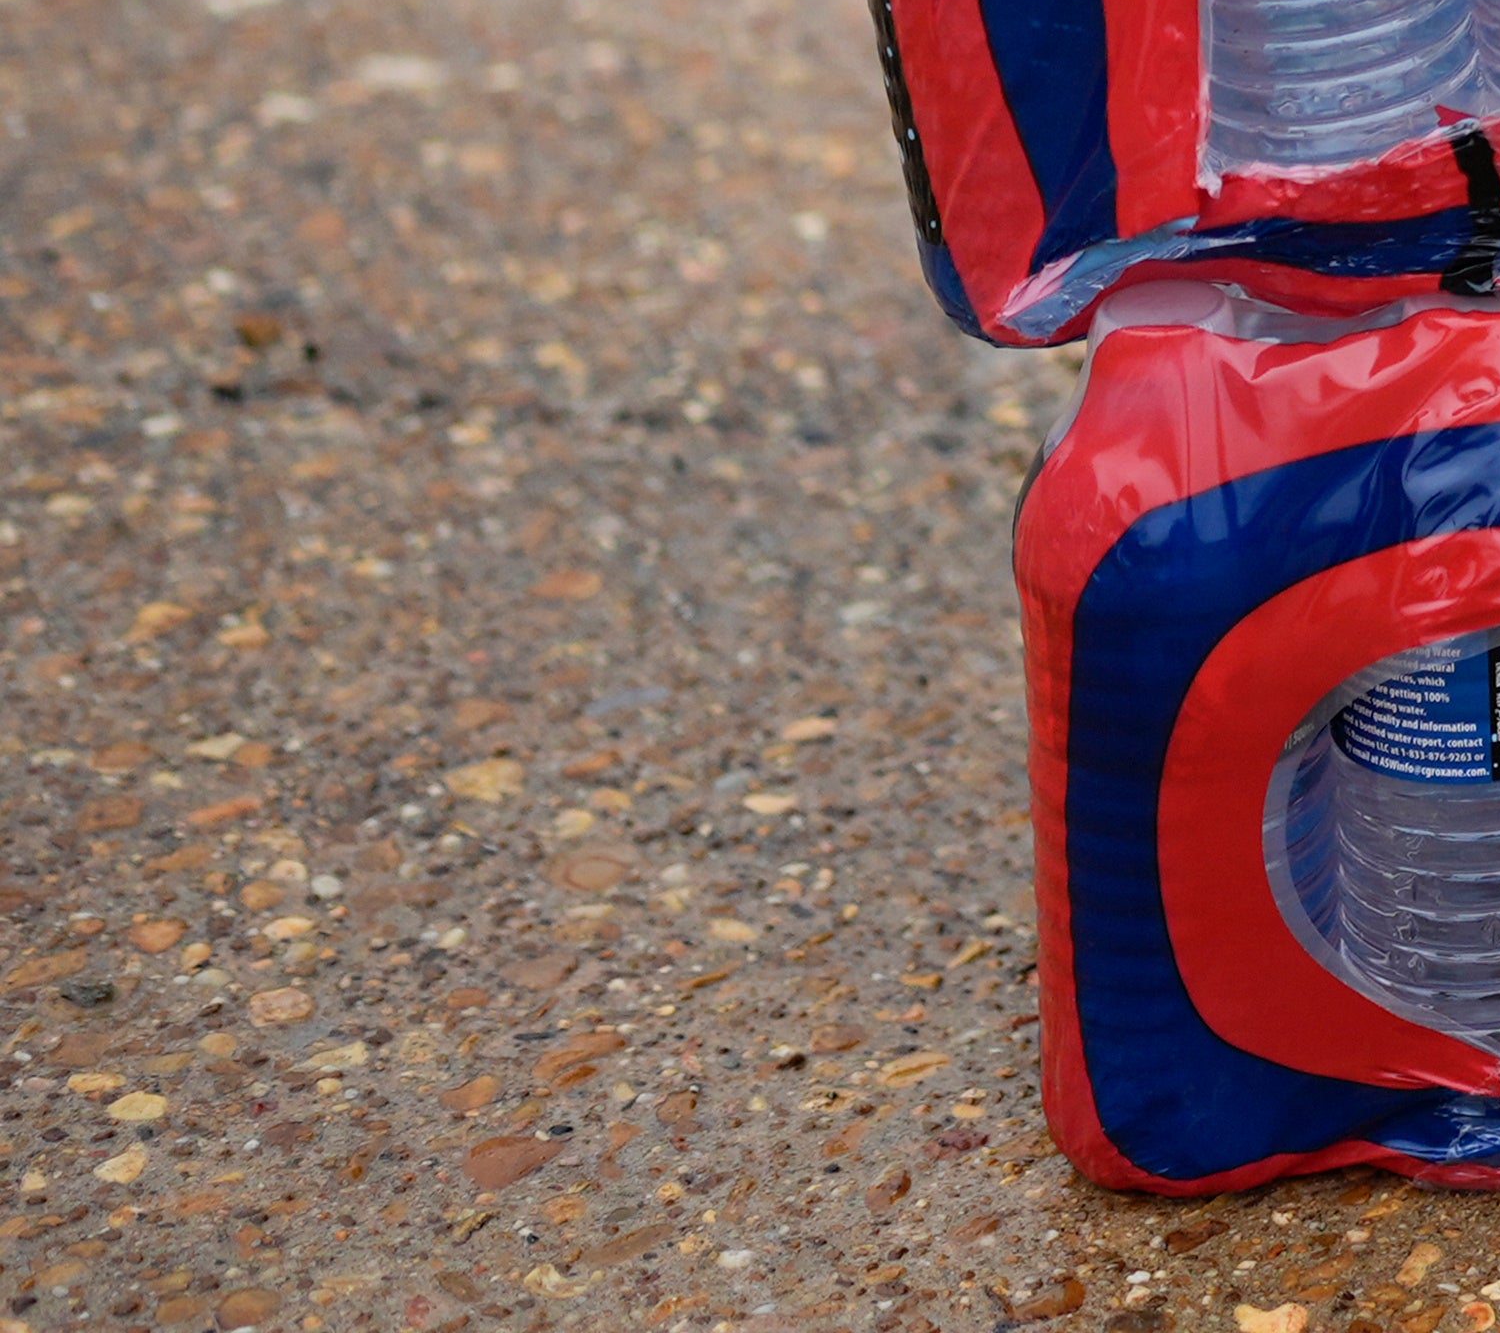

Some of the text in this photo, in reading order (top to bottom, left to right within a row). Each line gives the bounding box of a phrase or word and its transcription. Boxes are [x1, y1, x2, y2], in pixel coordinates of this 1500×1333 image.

[1417, 676, 1445, 687] which
[1390, 687, 1422, 703] getting
[1424, 691, 1450, 703] 100%
[1372, 698, 1427, 716] spring water.
[1352, 702, 1477, 733] water quality and information
[1360, 719, 1386, 738] bottled
[1387, 730, 1412, 744] water
[1413, 736, 1446, 749] report,
[1447, 737, 1483, 748] contact
[1352, 745, 1370, 761] email
[1370, 753, 1379, 764] at
[1376, 741, 1390, 753] LLC
[1390, 745, 1399, 756] at
[1474, 753, 1485, 762] or
